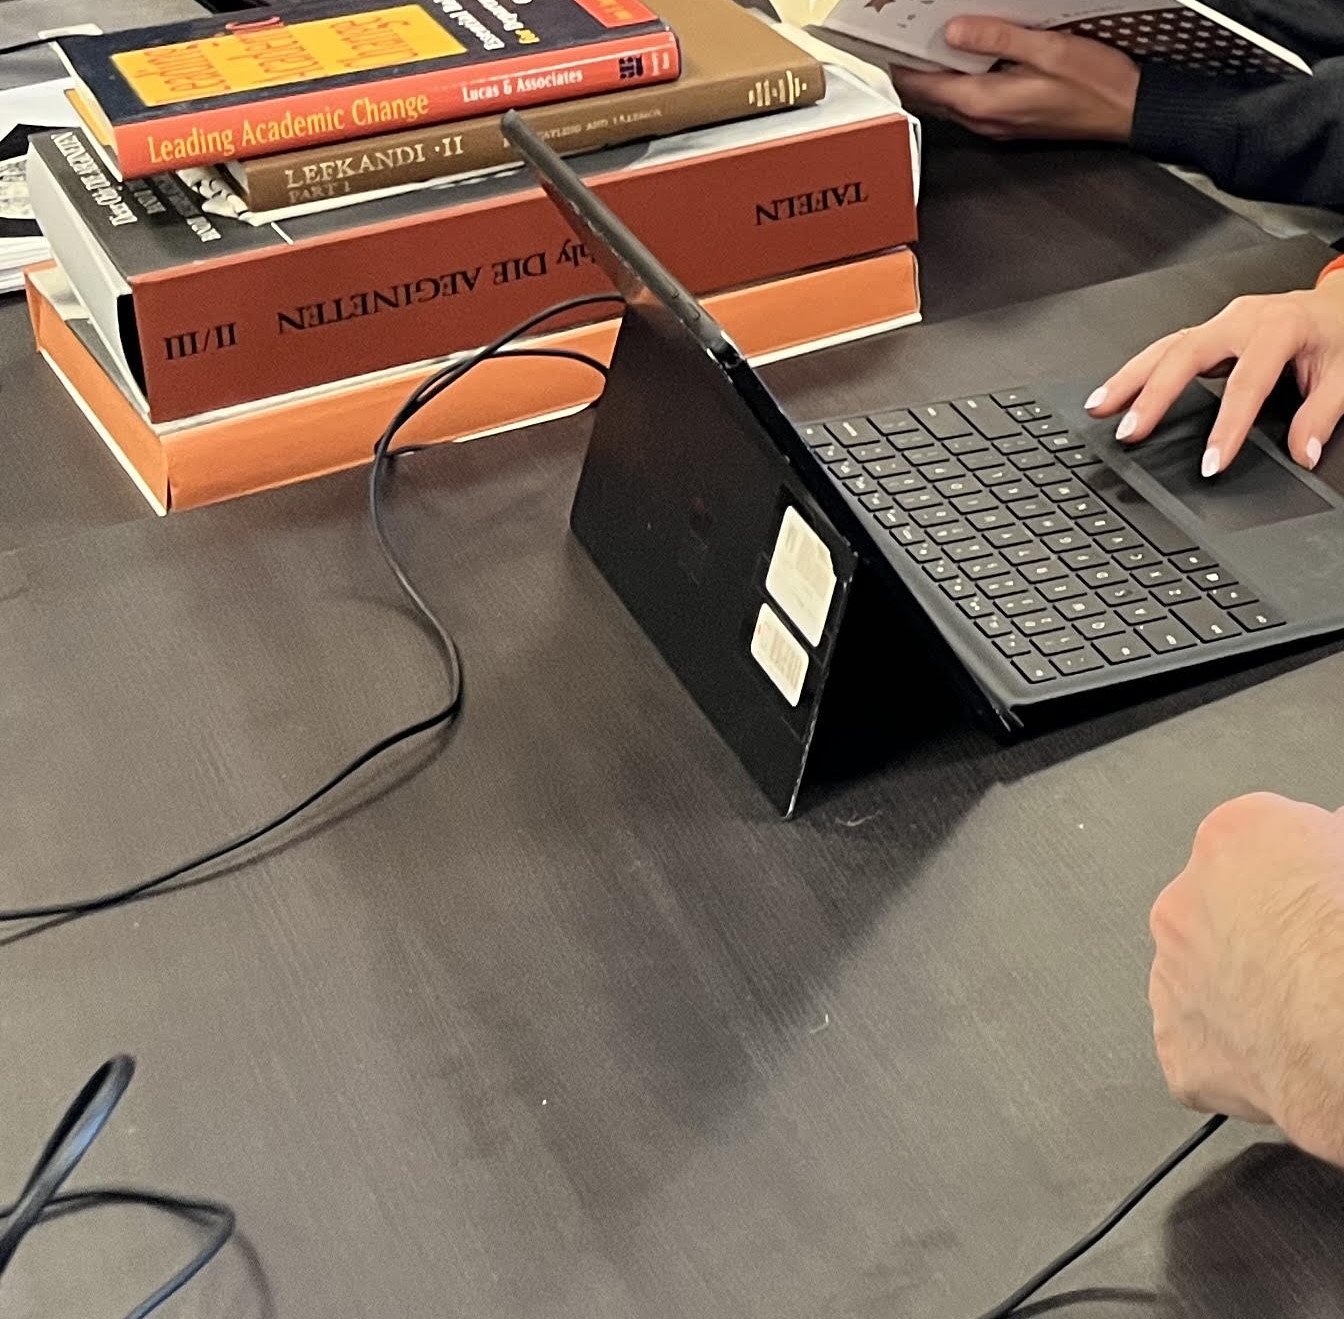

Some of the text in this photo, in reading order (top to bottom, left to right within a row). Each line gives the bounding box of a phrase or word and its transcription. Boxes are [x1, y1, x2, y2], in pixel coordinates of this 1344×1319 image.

[462, 69, 583, 103] Lucas & Associates
[148, 94, 429, 163] Leading Academic Change
[285, 143, 426, 189] LEFKANDI
[288, 183, 339, 204] PART
[755, 182, 869, 225] TAFELN
[493, 250, 548, 285] DIE
[276, 266, 482, 334] AEGINETEN
[164, 322, 238, 361] II/III
